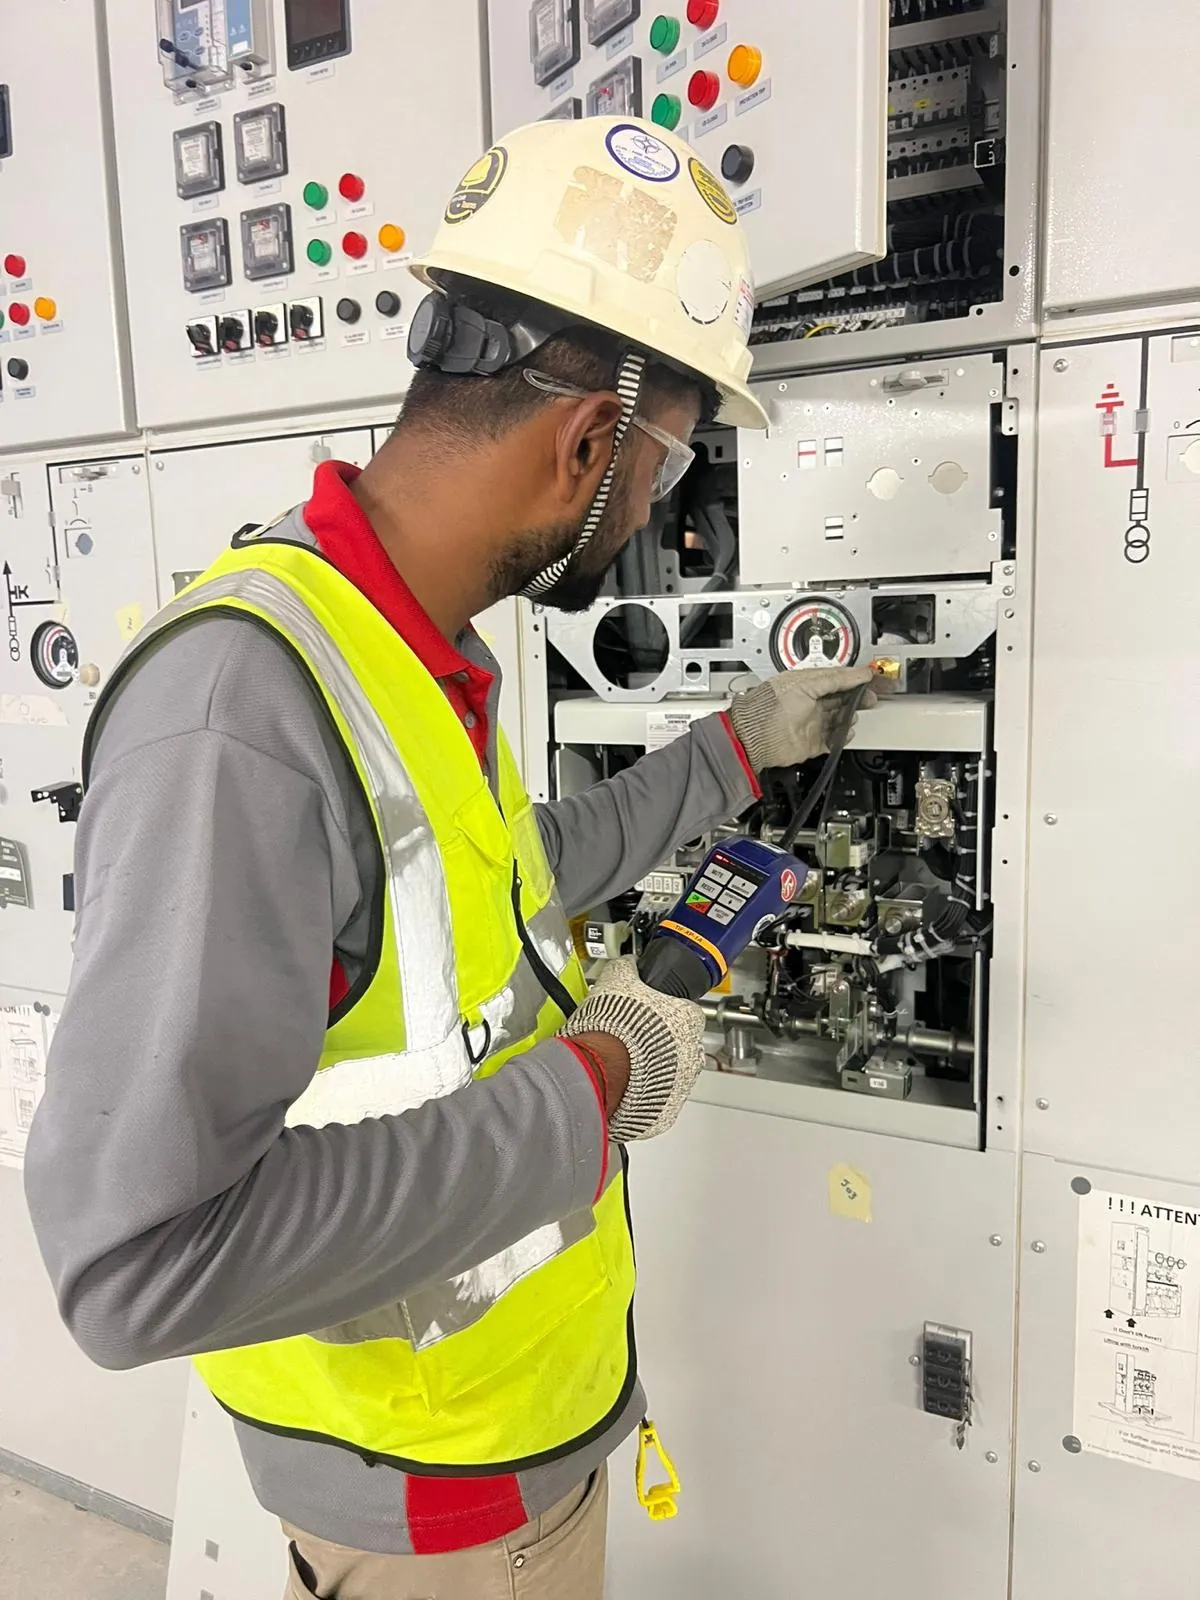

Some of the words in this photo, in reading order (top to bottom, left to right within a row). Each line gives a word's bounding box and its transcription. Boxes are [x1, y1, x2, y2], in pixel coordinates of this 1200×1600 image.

[711, 868, 724, 879] MUTE
[701, 882, 716, 894] RESET
[1140, 1204, 1200, 1226] ATTEN
